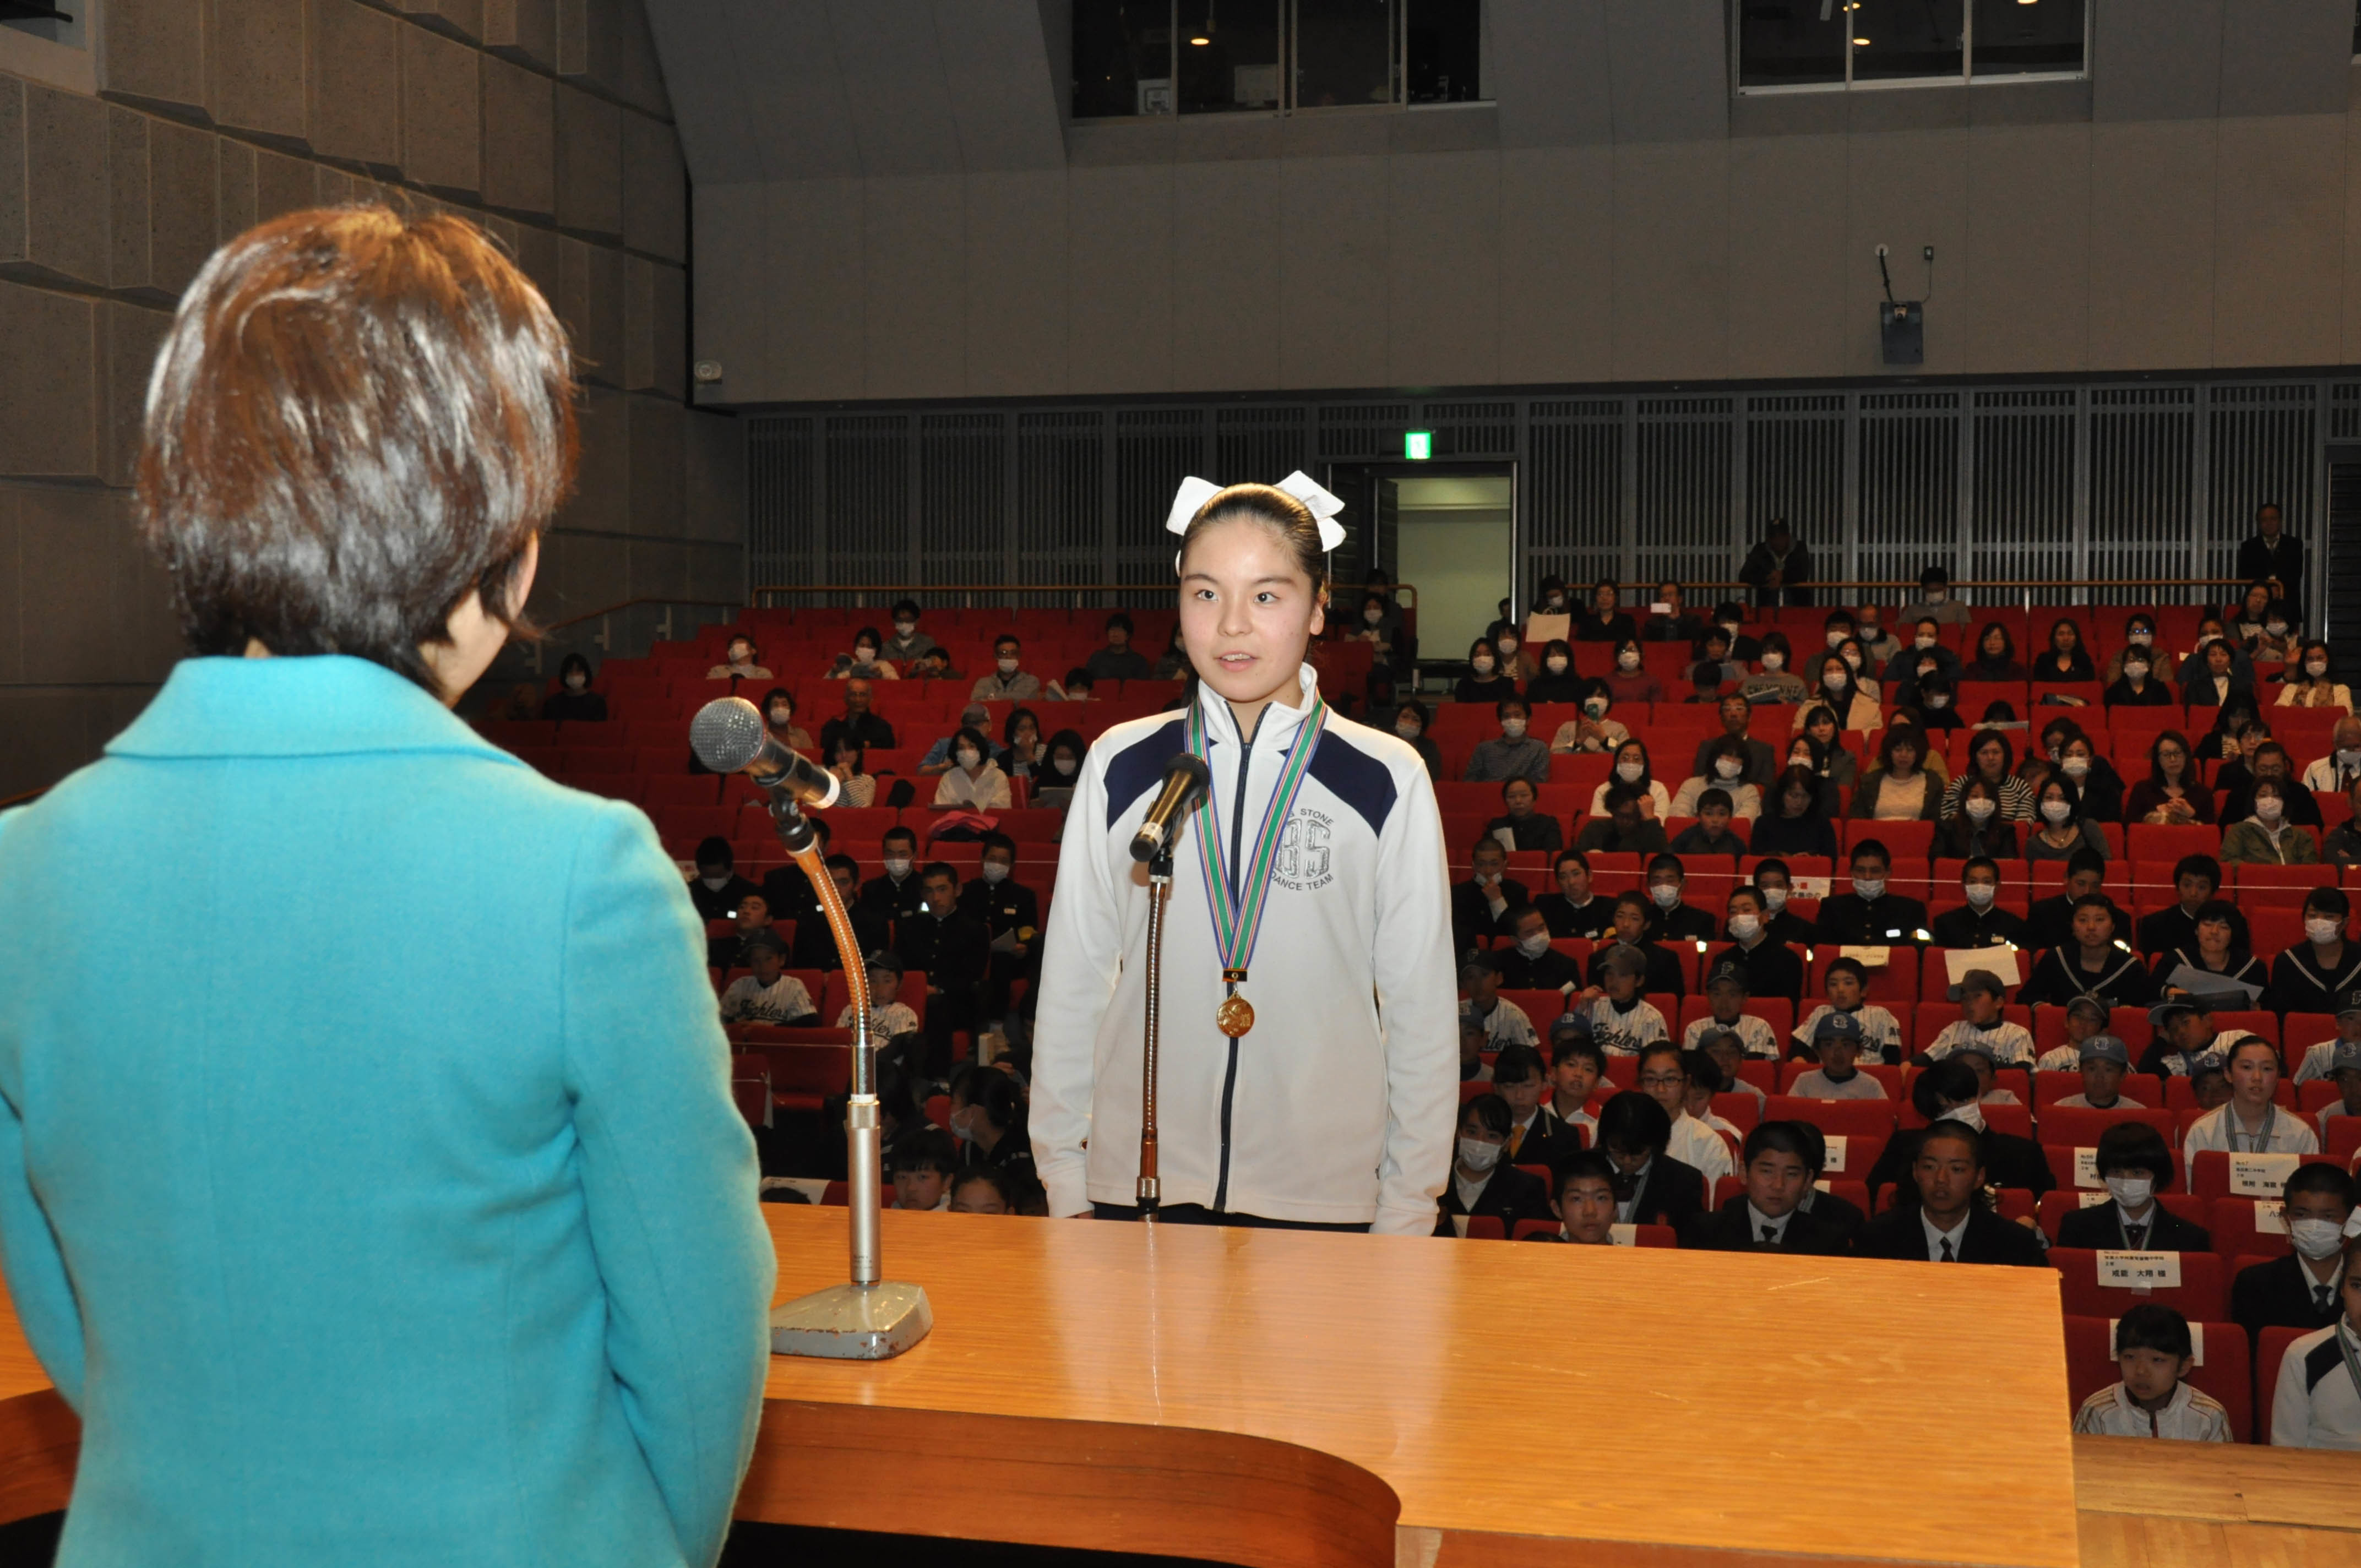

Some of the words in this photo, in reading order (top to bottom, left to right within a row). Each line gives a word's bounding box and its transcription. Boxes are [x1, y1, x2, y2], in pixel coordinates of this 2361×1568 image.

[1300, 808, 1334, 827] STONE
[1270, 870, 1303, 891] DANCE
[1306, 873, 1334, 891] TEAM
